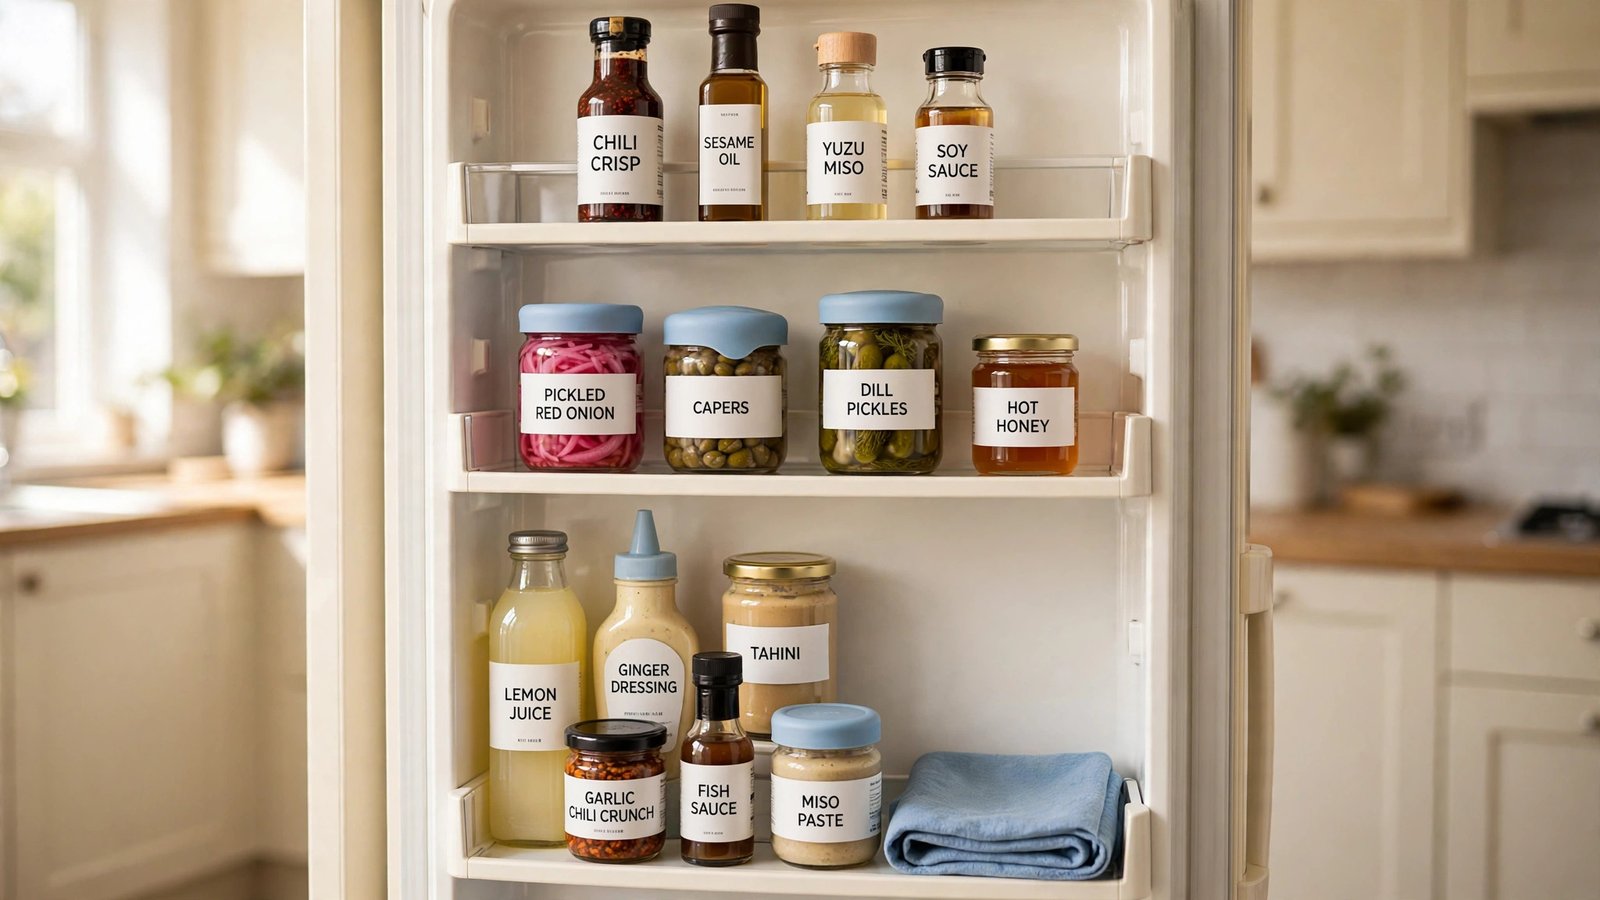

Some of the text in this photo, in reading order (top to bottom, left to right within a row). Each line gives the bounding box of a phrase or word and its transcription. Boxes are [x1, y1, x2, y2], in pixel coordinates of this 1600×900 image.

[594, 134, 637, 151] CHILI
[705, 135, 755, 149] SESAME
[823, 141, 865, 156] YUZU
[938, 143, 969, 159] SOY
[591, 155, 641, 172] CRISP
[719, 152, 741, 166] OIL
[825, 160, 865, 175] MISO
[929, 163, 979, 178] SAUCE
[545, 387, 606, 402] PICKLED
[862, 382, 894, 397] DILL
[537, 405, 615, 420] RED ONION
[694, 400, 750, 415] CAPERS
[848, 401, 908, 416] PICKLES
[1008, 400, 1039, 415] HOT
[997, 418, 1050, 433] HONEY
[751, 646, 801, 661] TAHINI
[619, 663, 670, 677] GINGER
[505, 687, 557, 702] LEMON
[612, 680, 678, 694] DRESSING
[510, 706, 552, 721] JUICE
[584, 790, 636, 806] GARLIC
[699, 783, 730, 798] FISH
[691, 801, 738, 816] SAUCE
[803, 794, 840, 810] MISO
[569, 805, 655, 823] CHILI CRUNCH
[799, 812, 844, 828] PASTE
